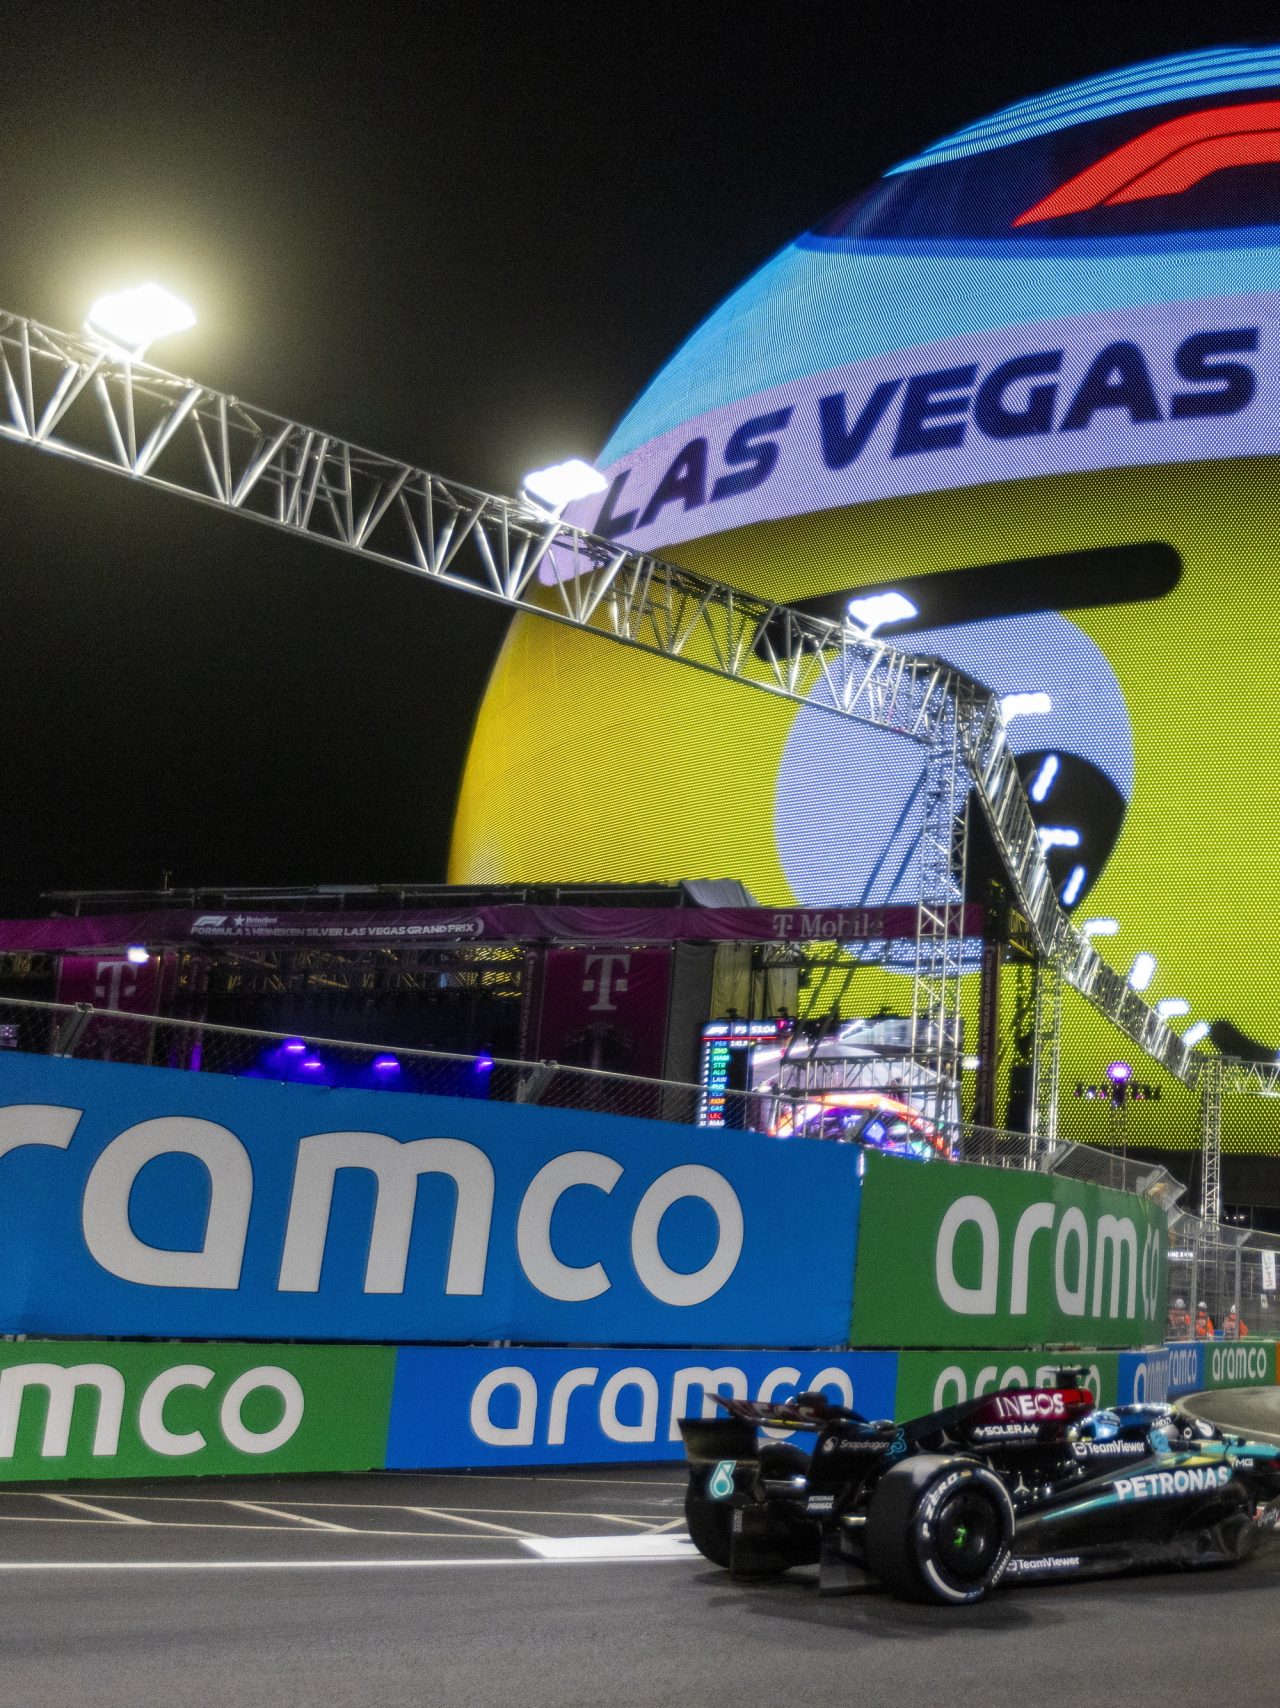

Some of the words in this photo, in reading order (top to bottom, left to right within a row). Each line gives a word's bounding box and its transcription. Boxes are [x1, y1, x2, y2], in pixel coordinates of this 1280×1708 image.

[595, 405, 793, 538] LAS
[818, 326, 1258, 472] VEGAS
[191, 927, 243, 936] FORMULA
[253, 927, 305, 936] HEINEKEN
[307, 927, 343, 936] SILVER
[344, 927, 367, 936] LAS
[368, 926, 406, 936] VEGAS
[407, 925, 447, 934] GRAND
[447, 923, 474, 933] PRIX
[801, 913, 885, 937] Mobile
[936, 1195, 1160, 1321] aramco
[1212, 1347, 1267, 1381] aramco
[996, 1393, 1064, 1417] INEOS
[984, 1423, 1030, 1436] SOLERA
[840, 1440, 890, 1451] Snapdragon
[1088, 1440, 1145, 1454] TeamViewer
[1113, 1466, 1230, 1500] PETRONAS
[1017, 1556, 1080, 1569] TeamViewer
